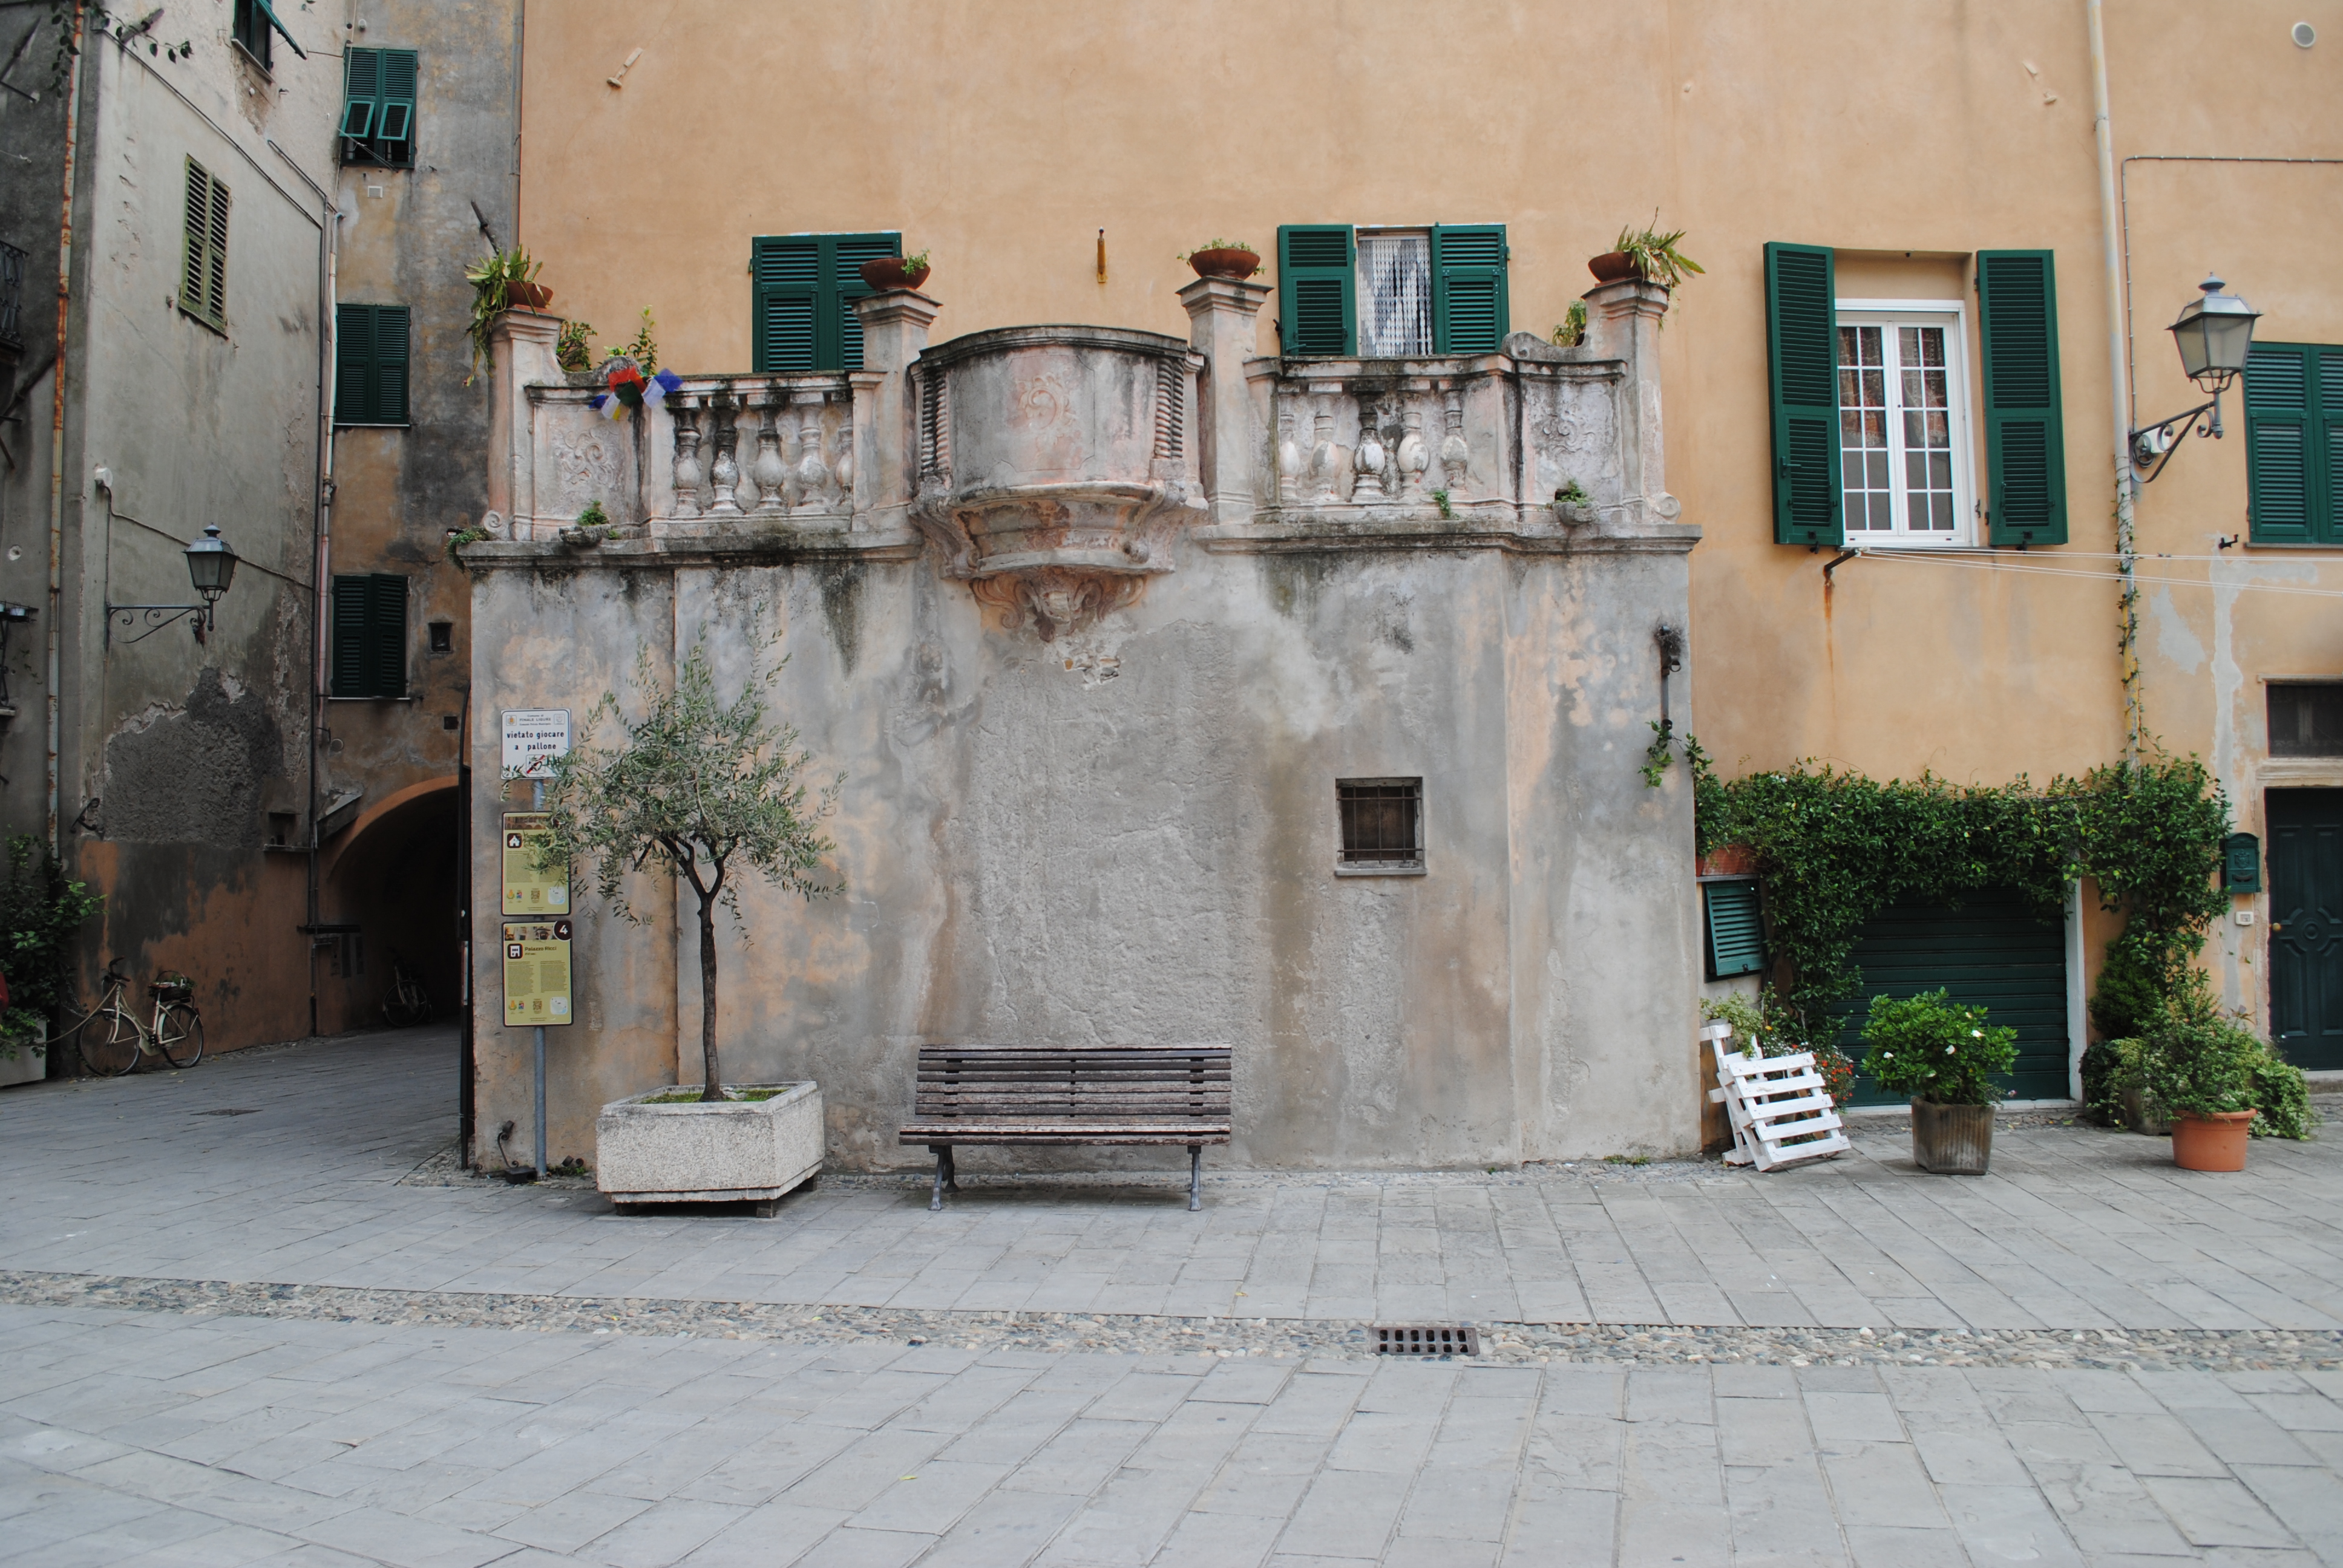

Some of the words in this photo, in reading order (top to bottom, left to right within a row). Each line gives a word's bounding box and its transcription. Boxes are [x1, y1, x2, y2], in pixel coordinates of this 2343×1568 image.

[536, 730, 565, 739] giocare
[528, 742, 556, 751] pallone
[559, 925, 568, 935] 4
